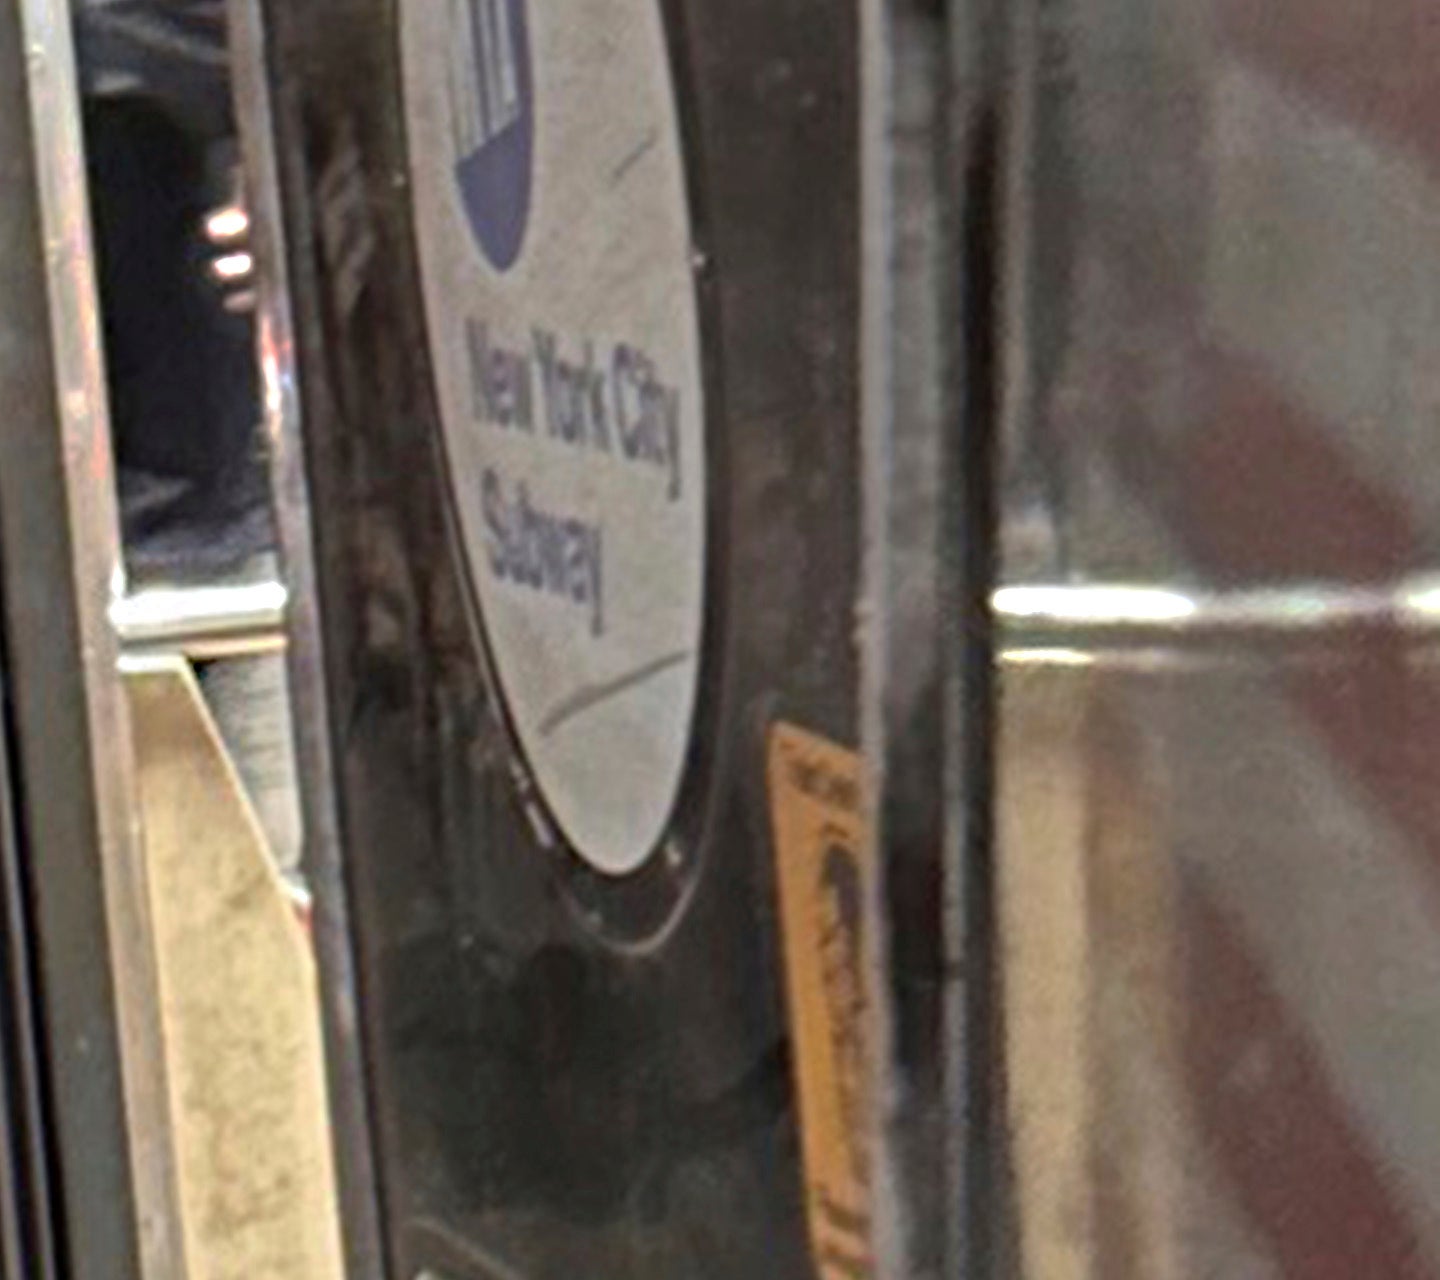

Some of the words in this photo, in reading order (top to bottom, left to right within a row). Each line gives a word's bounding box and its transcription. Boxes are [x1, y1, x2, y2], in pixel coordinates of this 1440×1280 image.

[466, 317, 533, 434] New
[531, 326, 611, 454] York
[610, 342, 680, 502] City
[482, 468, 602, 636] Subway
